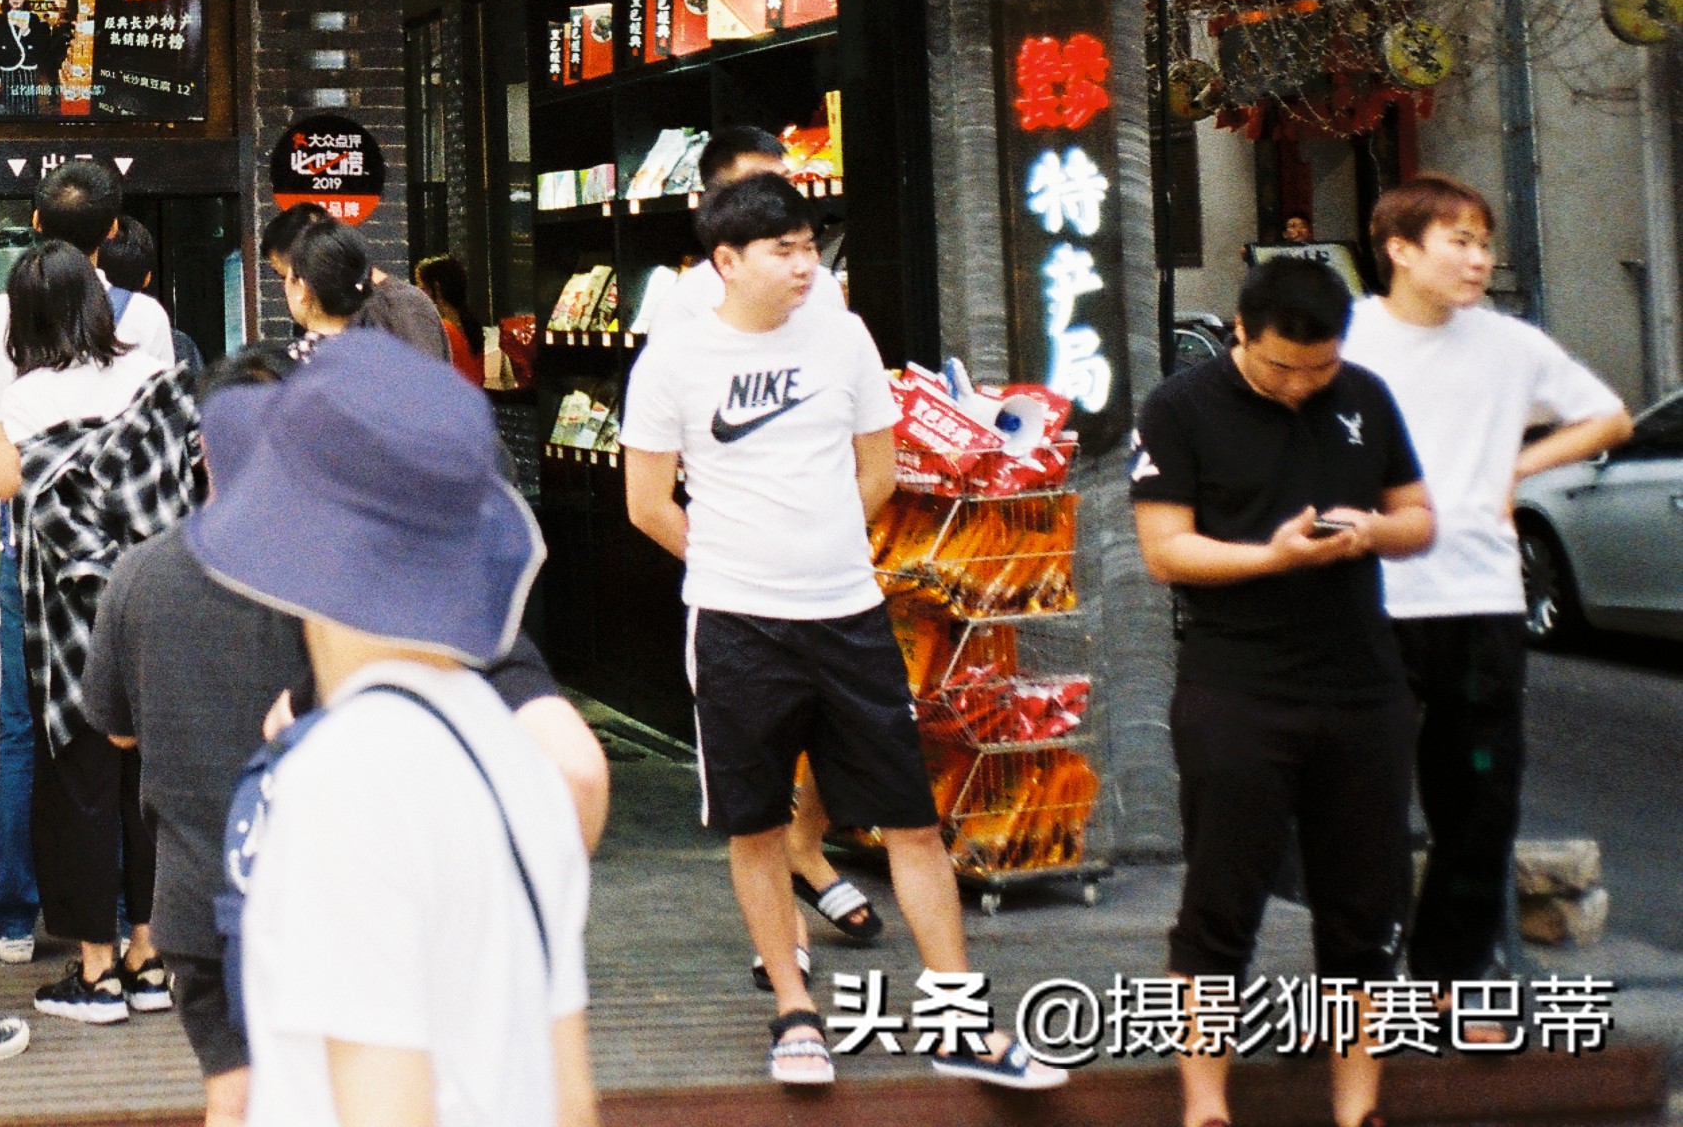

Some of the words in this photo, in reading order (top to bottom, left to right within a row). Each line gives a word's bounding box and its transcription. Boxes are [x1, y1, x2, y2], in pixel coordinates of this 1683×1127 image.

[308, 134, 362, 148] 大众点评
[290, 149, 364, 176] 必吃榜
[312, 177, 343, 190] 2019
[727, 367, 801, 410] NIKE
